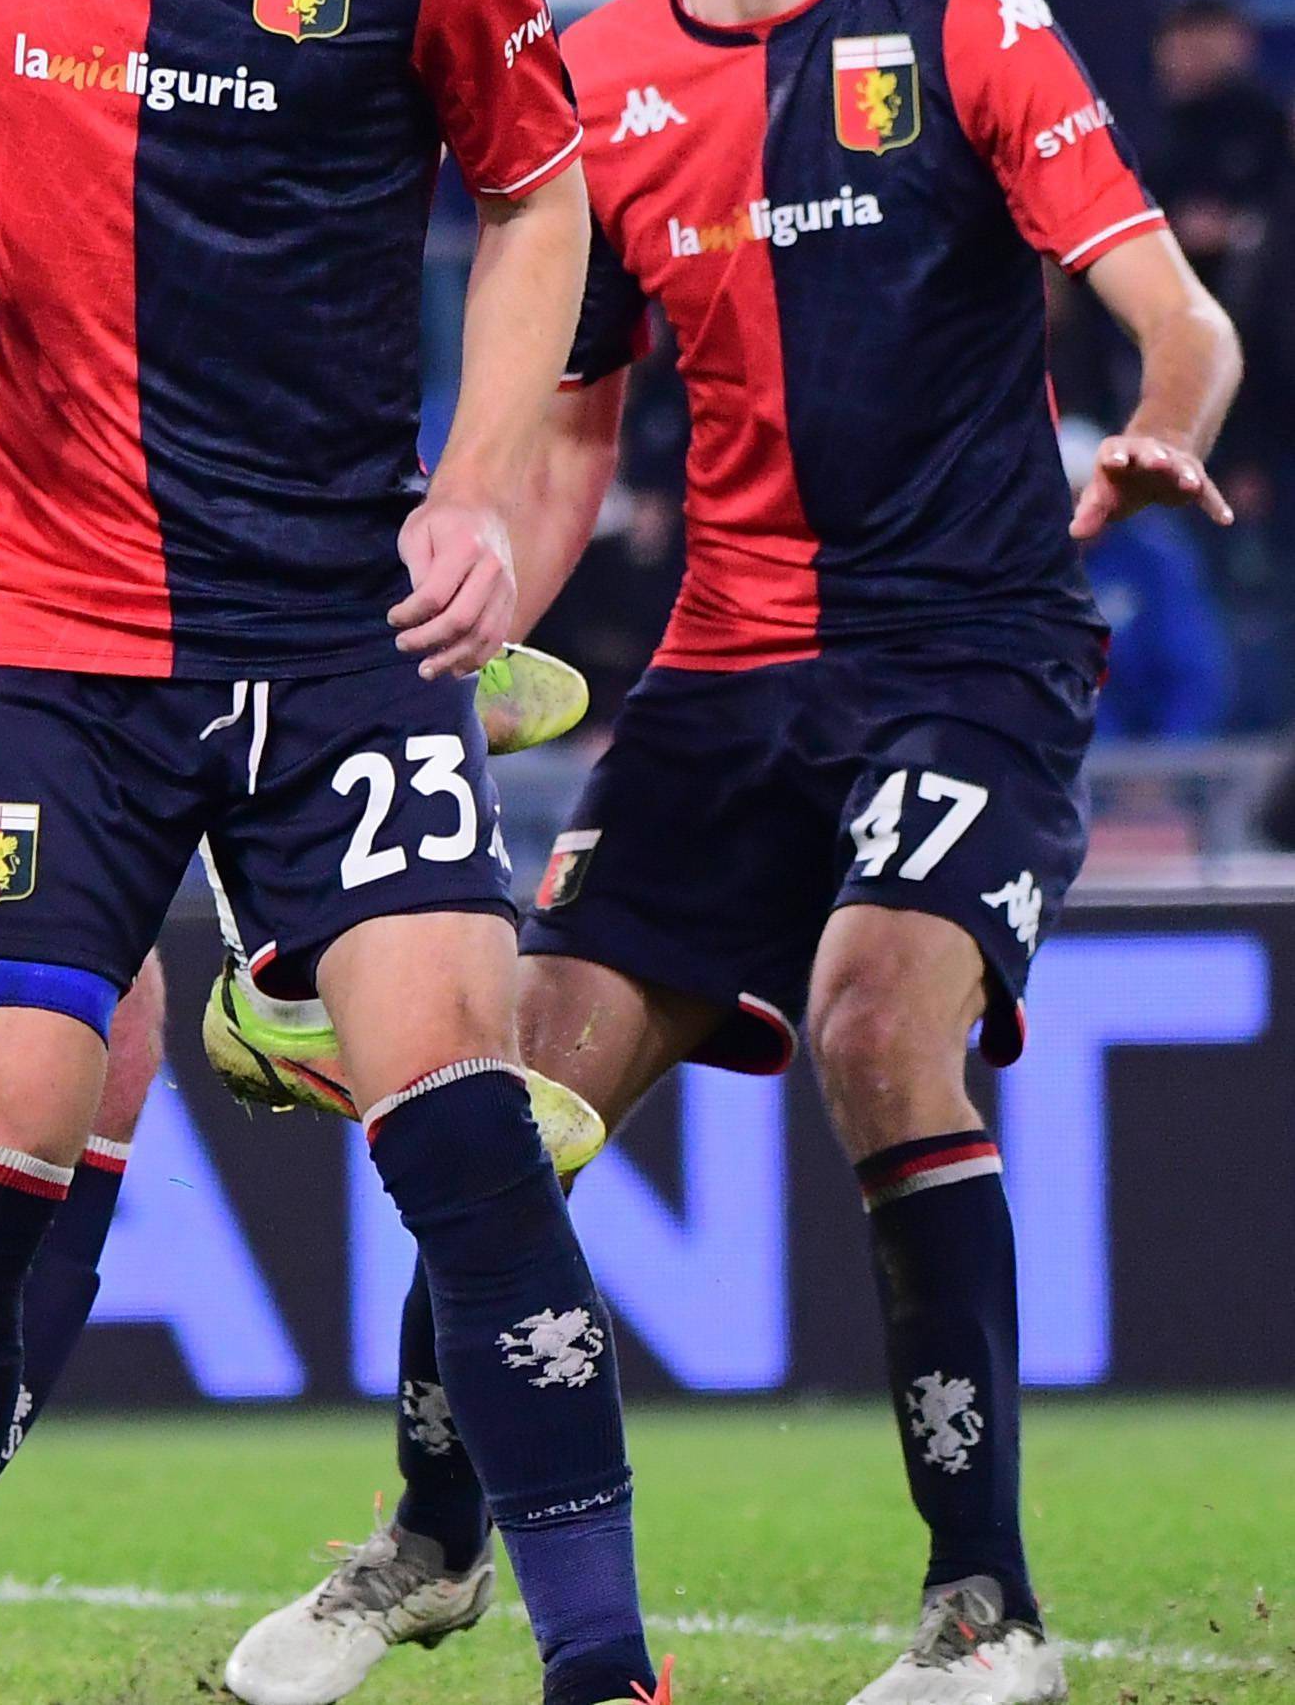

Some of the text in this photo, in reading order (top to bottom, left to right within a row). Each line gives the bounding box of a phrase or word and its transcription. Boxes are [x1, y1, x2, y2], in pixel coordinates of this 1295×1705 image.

[14, 32, 278, 112] lamialiguria
[1034, 97, 1114, 159] SYNL
[331, 734, 477, 890] 23
[849, 768, 989, 882] 47
